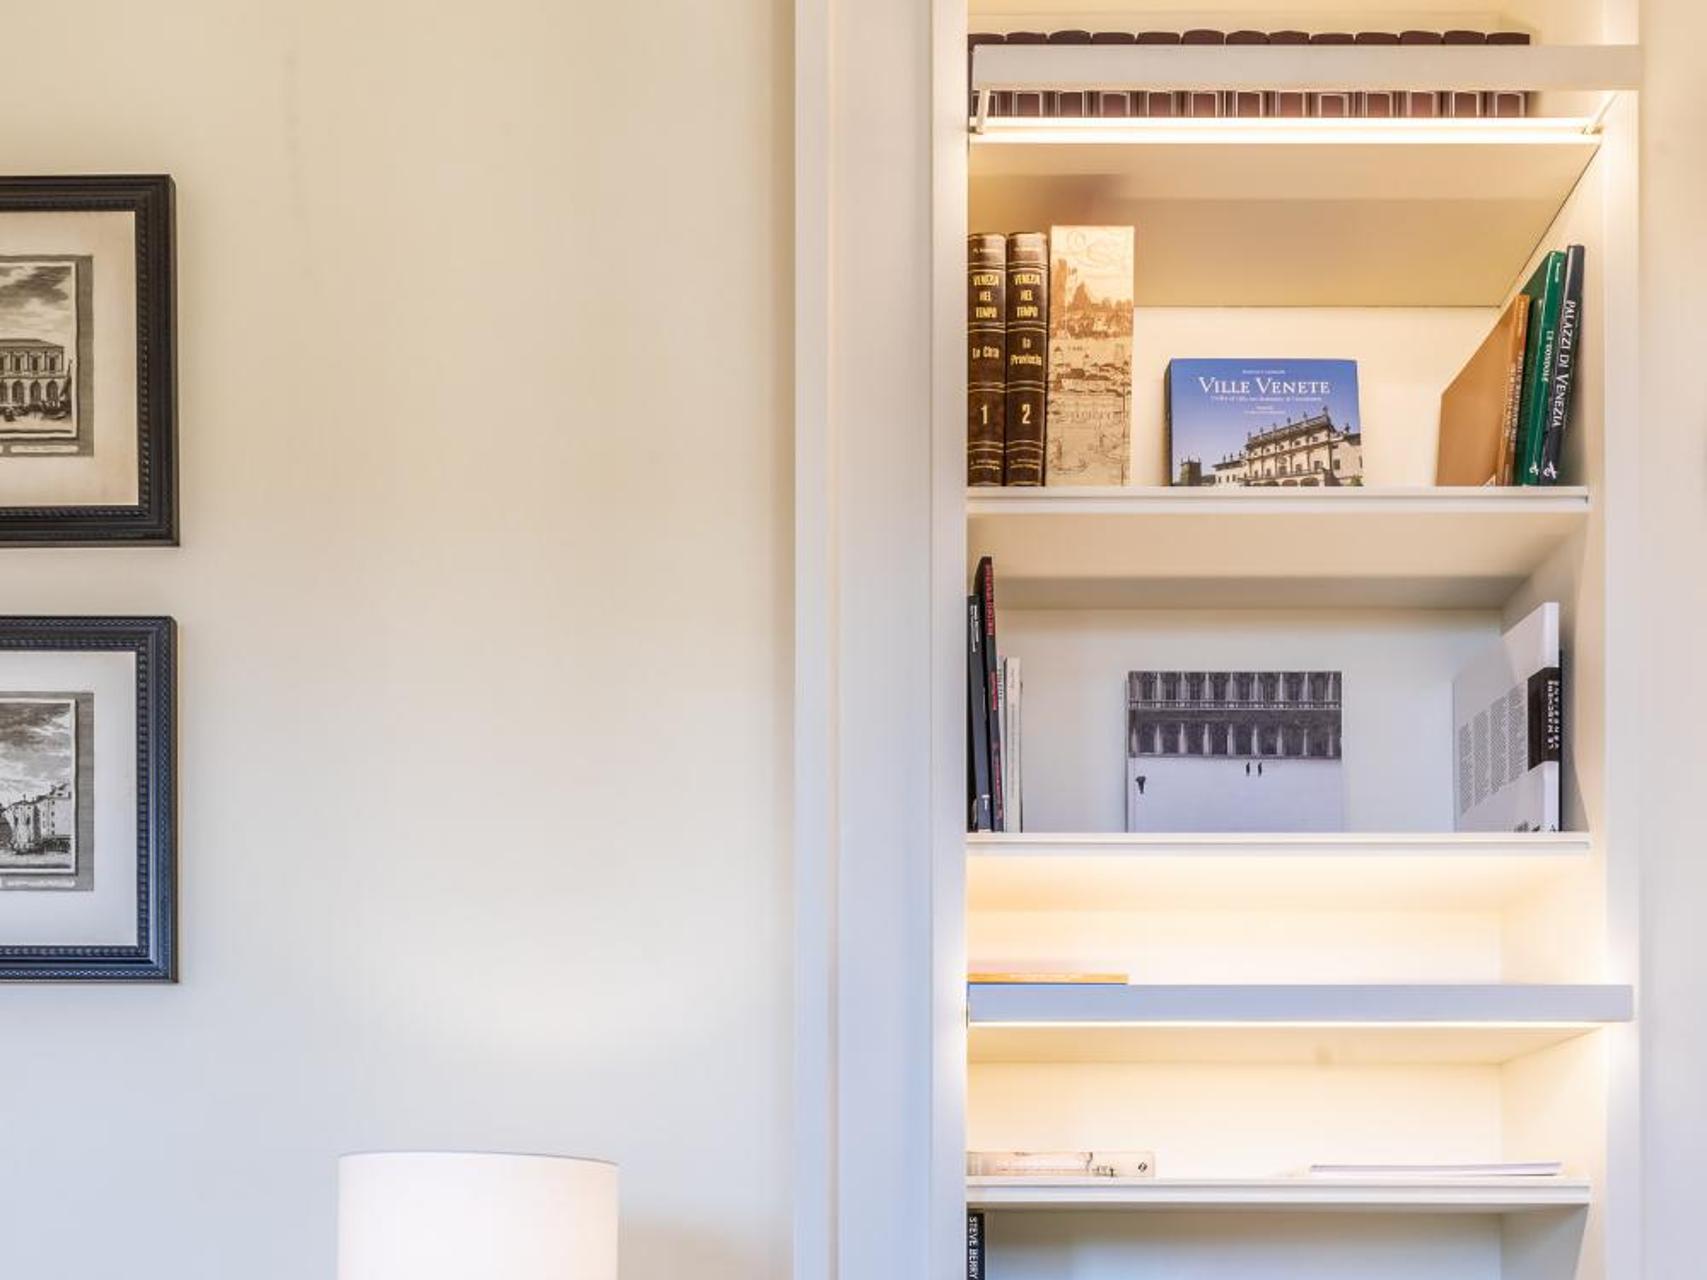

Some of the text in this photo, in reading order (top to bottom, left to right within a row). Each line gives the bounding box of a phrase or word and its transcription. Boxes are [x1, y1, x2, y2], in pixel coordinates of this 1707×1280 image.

[1551, 300, 1576, 428] PALAZZI DI VENEZIA
[981, 404, 988, 425] 1
[1021, 403, 1032, 425] 2
[968, 1216, 979, 1247] STEVE
[968, 1248, 980, 1280] BERRY
